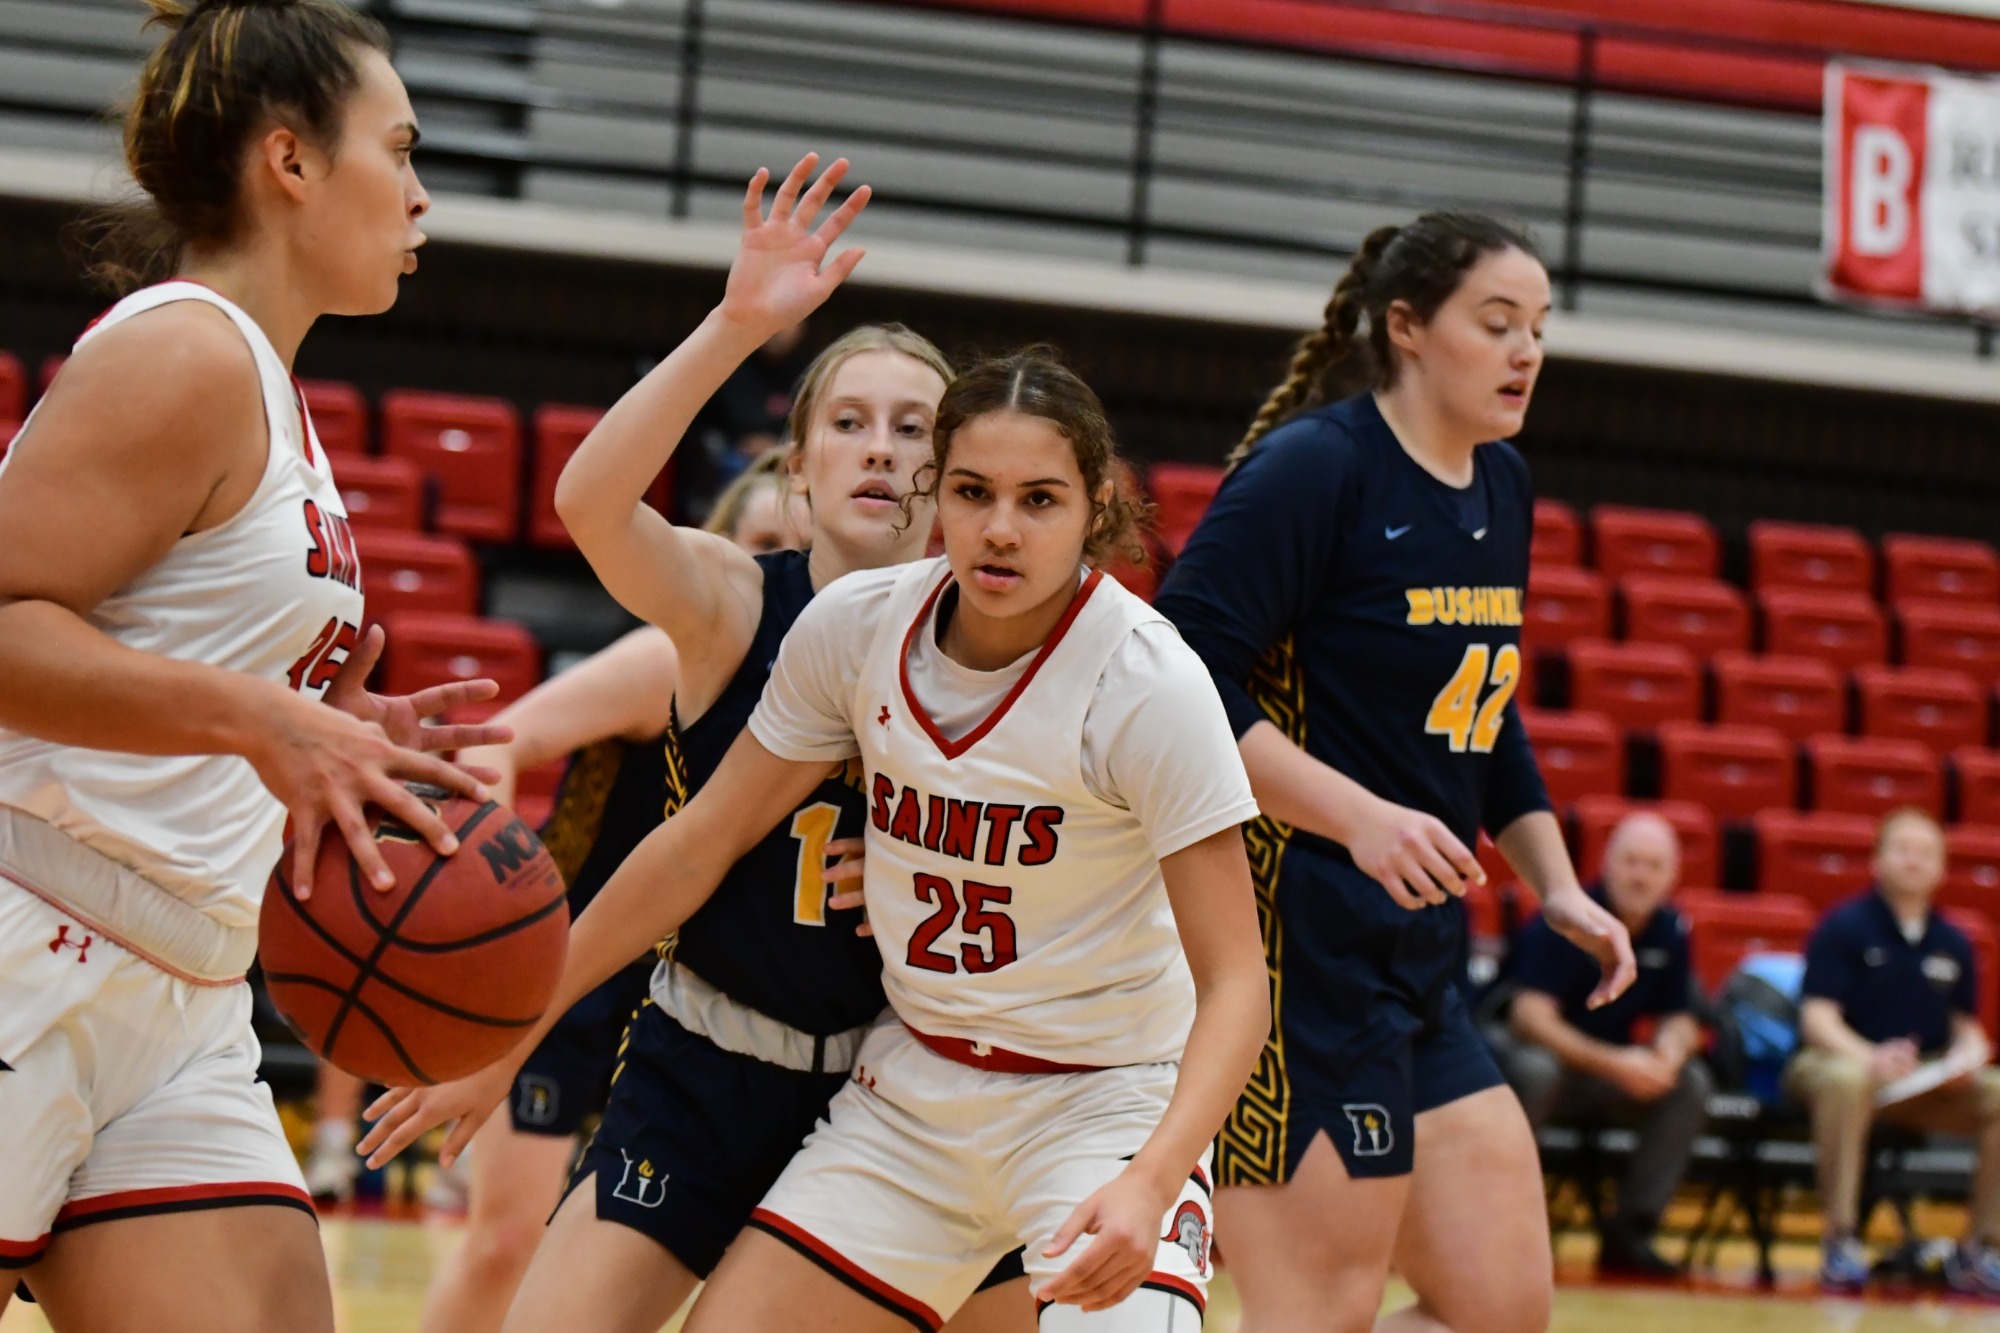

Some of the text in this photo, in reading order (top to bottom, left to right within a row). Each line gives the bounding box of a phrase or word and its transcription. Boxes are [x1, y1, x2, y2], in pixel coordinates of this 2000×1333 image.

[1850, 123, 1914, 257] B
[1424, 643, 1522, 754] 42
[871, 772, 1065, 866] SAINTS
[905, 871, 1018, 975] 25
